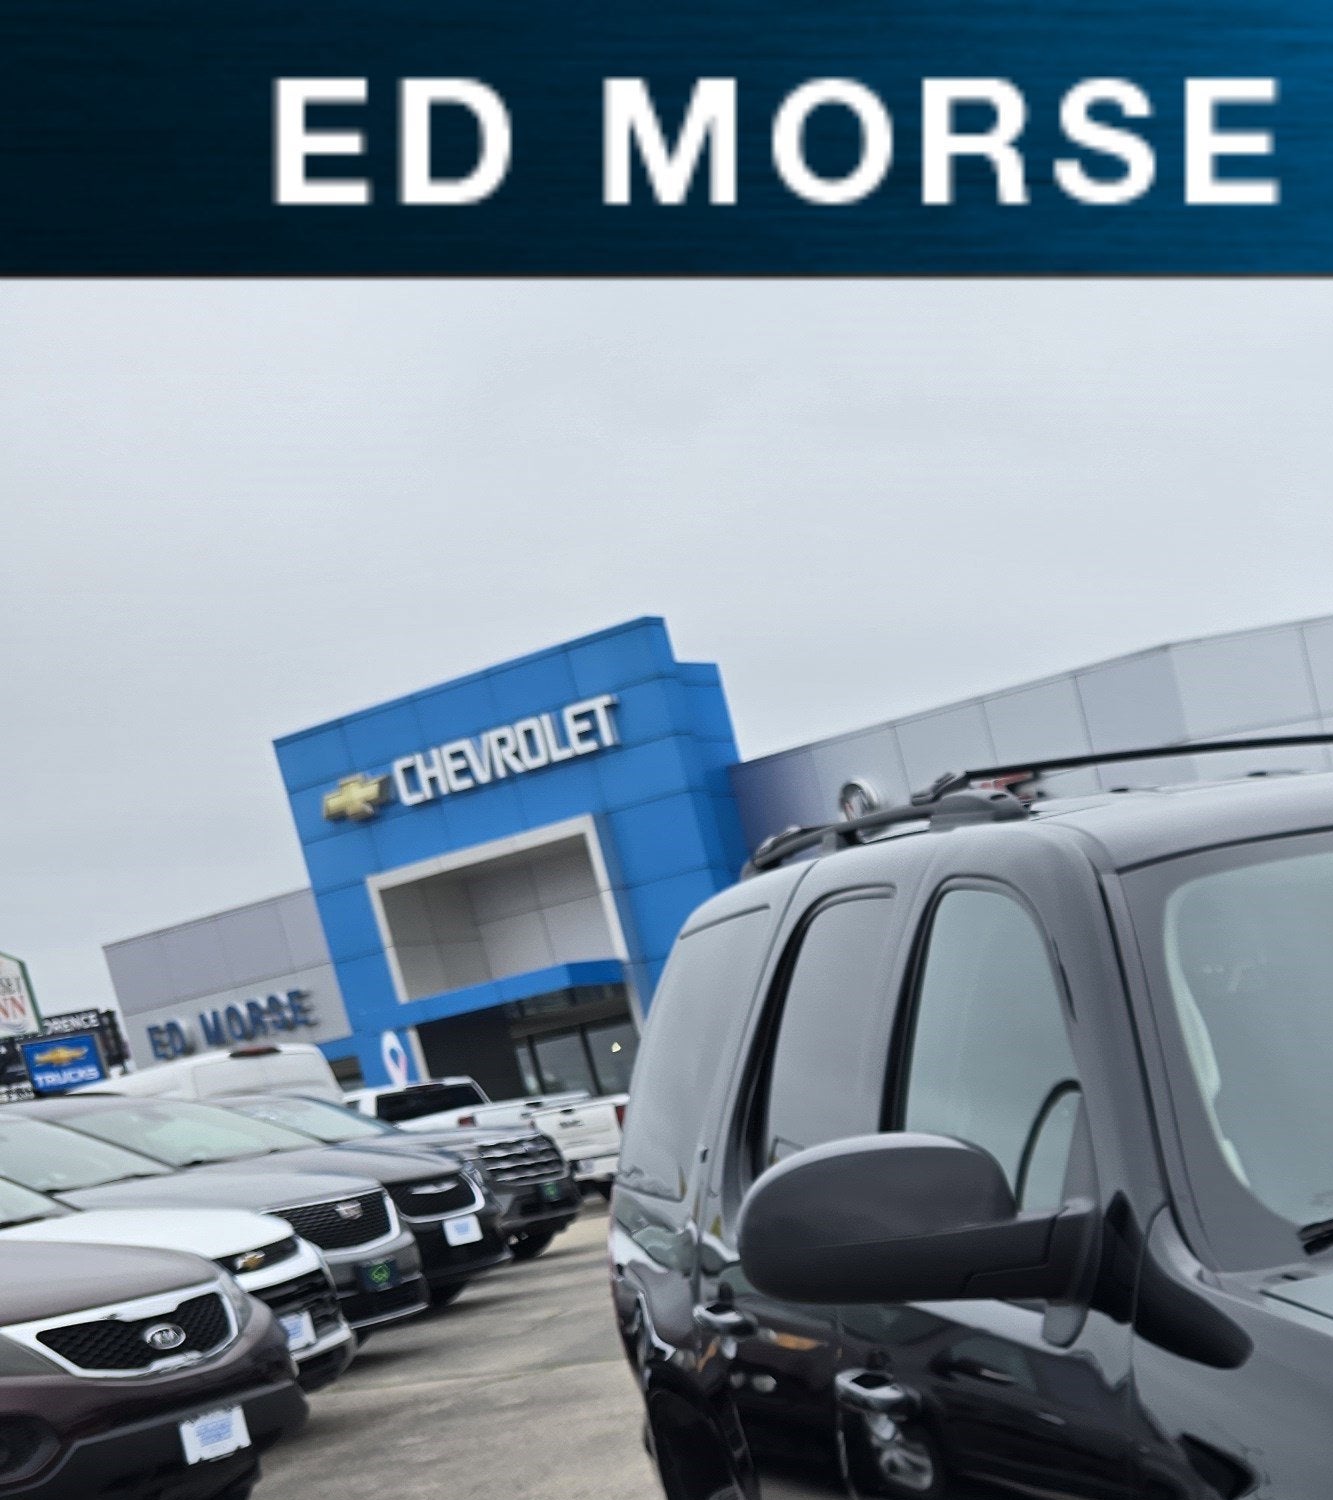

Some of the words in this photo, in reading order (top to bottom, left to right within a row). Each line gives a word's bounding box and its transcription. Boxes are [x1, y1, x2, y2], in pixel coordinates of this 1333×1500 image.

[392, 694, 620, 806] CHEVROLET
[147, 1020, 190, 1061] ED
[199, 990, 319, 1047] MORSE
[34, 1065, 100, 1089] TRUCKS
